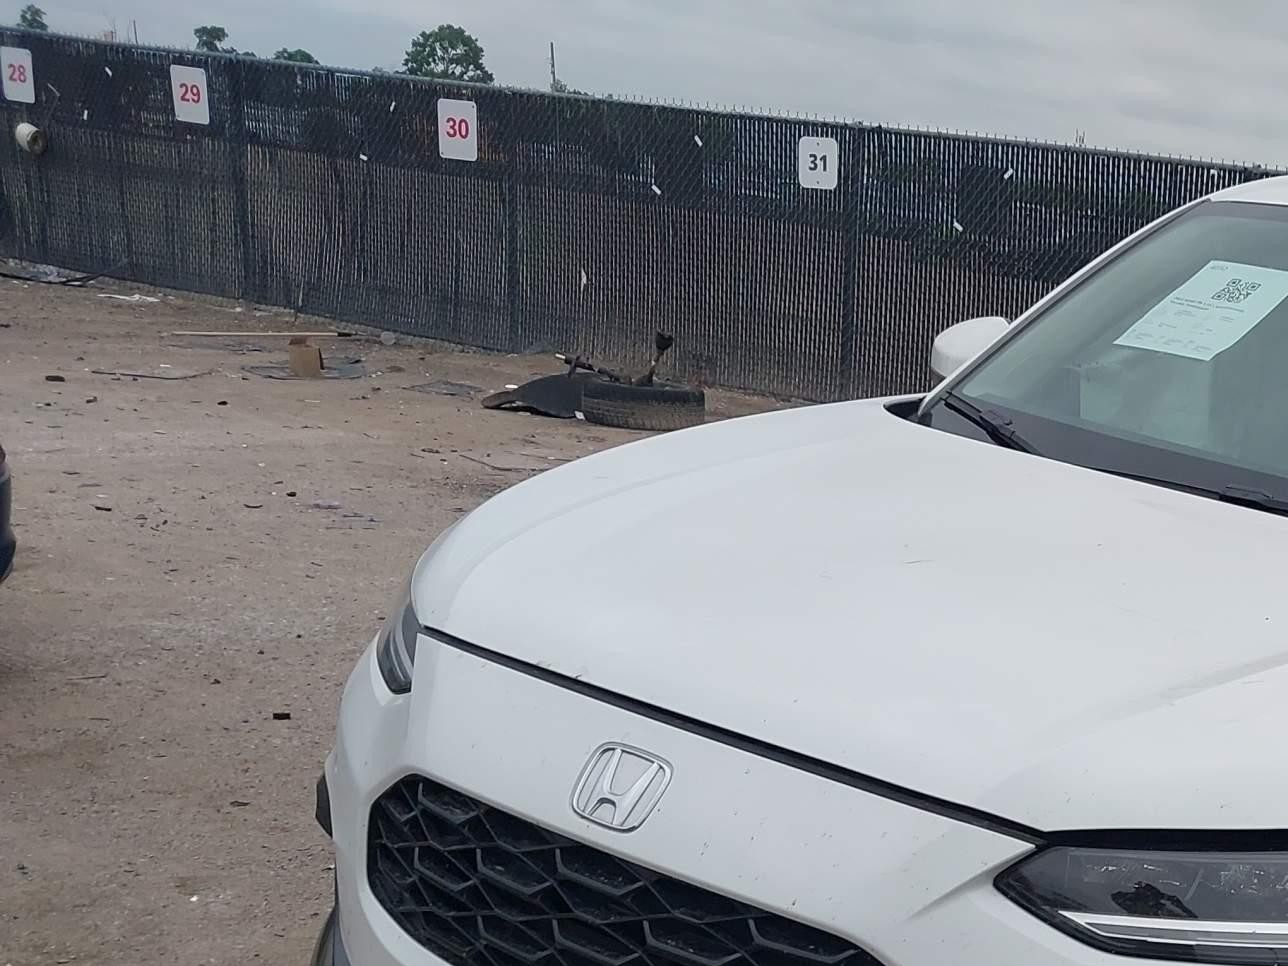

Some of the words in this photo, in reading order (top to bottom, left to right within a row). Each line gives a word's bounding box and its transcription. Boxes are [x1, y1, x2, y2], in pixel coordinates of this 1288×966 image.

[7, 63, 27, 84] 28
[179, 82, 201, 104] 29
[446, 117, 469, 139] 30
[808, 153, 828, 172] 31
